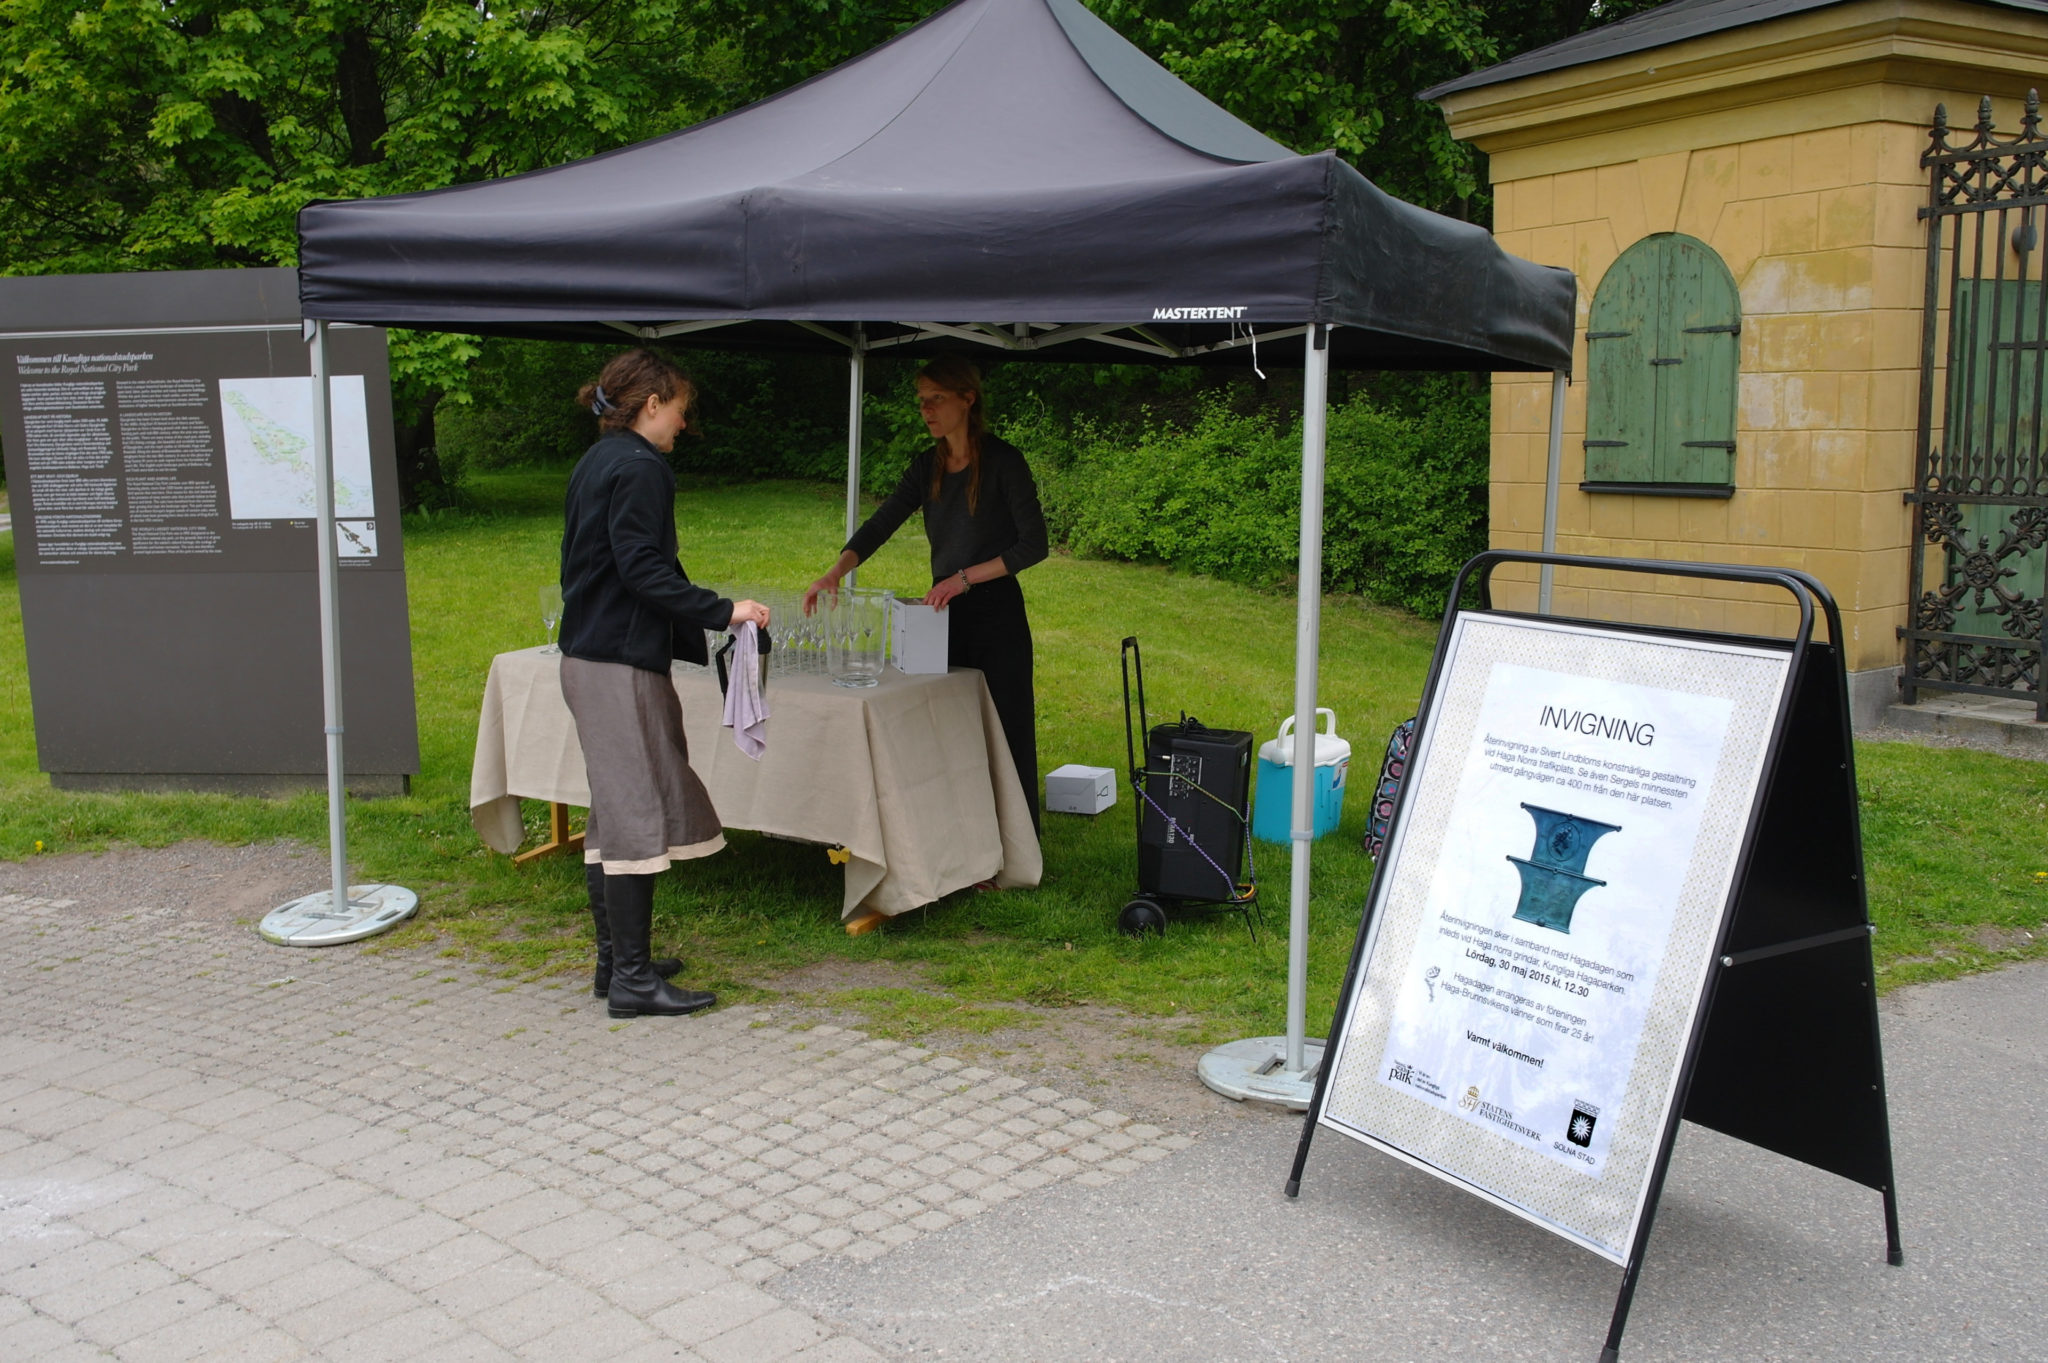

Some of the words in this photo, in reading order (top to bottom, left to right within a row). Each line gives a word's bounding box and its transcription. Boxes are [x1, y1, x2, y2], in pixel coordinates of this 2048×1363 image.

[1153, 307, 1244, 319] MASTERTENT
[18, 365, 43, 375] Welcome
[61, 364, 80, 375] Royal
[80, 363, 108, 374] National
[108, 363, 122, 374] City
[122, 362, 139, 373] Park
[1540, 705, 1655, 747] INVIGNING
[1484, 749, 1495, 757] vid
[1497, 750, 1515, 762] Haga
[1517, 754, 1538, 766] Norra
[1577, 767, 1589, 777] Se
[1589, 771, 1608, 781] även
[1610, 774, 1640, 789] Sergels
[1641, 783, 1688, 799] minnessten
[1489, 762, 1514, 774] utmed
[1514, 766, 1555, 783] gångvägen
[1556, 777, 1565, 786] ca
[1567, 779, 1582, 789] 400
[1583, 783, 1592, 791] m
[1593, 784, 1608, 795] från
[1609, 788, 1625, 799] den
[1626, 791, 1640, 803] här
[1641, 796, 1672, 810] platsen.
[1530, 746, 1539, 754] av
[1540, 746, 1561, 758] Sivert
[1562, 751, 1601, 767] Lindbloms
[1603, 760, 1650, 778] konstnärliga
[1651, 771, 1696, 789] gestaltning
[1439, 926, 1460, 939] inleds
[1461, 934, 1472, 943] vid
[1472, 936, 1492, 951] Haga
[1493, 944, 1513, 957] norra
[1513, 951, 1540, 967] grindar,
[1542, 959, 1575, 978] Kungliga
[1576, 970, 1626, 995] Hagaparken.
[1465, 947, 1497, 968] Lördag,
[1498, 959, 1510, 970] 30
[1511, 965, 1528, 978] maj
[1529, 969, 1550, 984] 2015
[1552, 977, 1561, 989] kl.
[1565, 982, 1590, 997] 12.30
[1494, 930, 1510, 941] sker
[1514, 937, 1550, 954] samband
[1551, 948, 1569, 960] med
[1569, 953, 1615, 975] Hagadagen
[1616, 970, 1635, 982] som
[1440, 980, 1509, 1013] Haga-Brunnsvikens
[1510, 1006, 1535, 1021] vänner
[1535, 1016, 1553, 1029] som
[1554, 1021, 1570, 1034] firar
[1570, 1028, 1582, 1039] 25
[1454, 971, 1495, 992] Hagadagen
[1496, 988, 1535, 1008] arrangeras
[1535, 1002, 1545, 1012] av
[1546, 1004, 1587, 1026] föreningen
[1466, 1029, 1491, 1047] Varmt
[1492, 1041, 1545, 1068] välkommen!
[1479, 1109, 1542, 1142] FASTIGHETSVERK
[1481, 1101, 1512, 1119] STATENS
[1553, 1141, 1576, 1158] SOLNA
[1577, 1151, 1596, 1165] STAD
